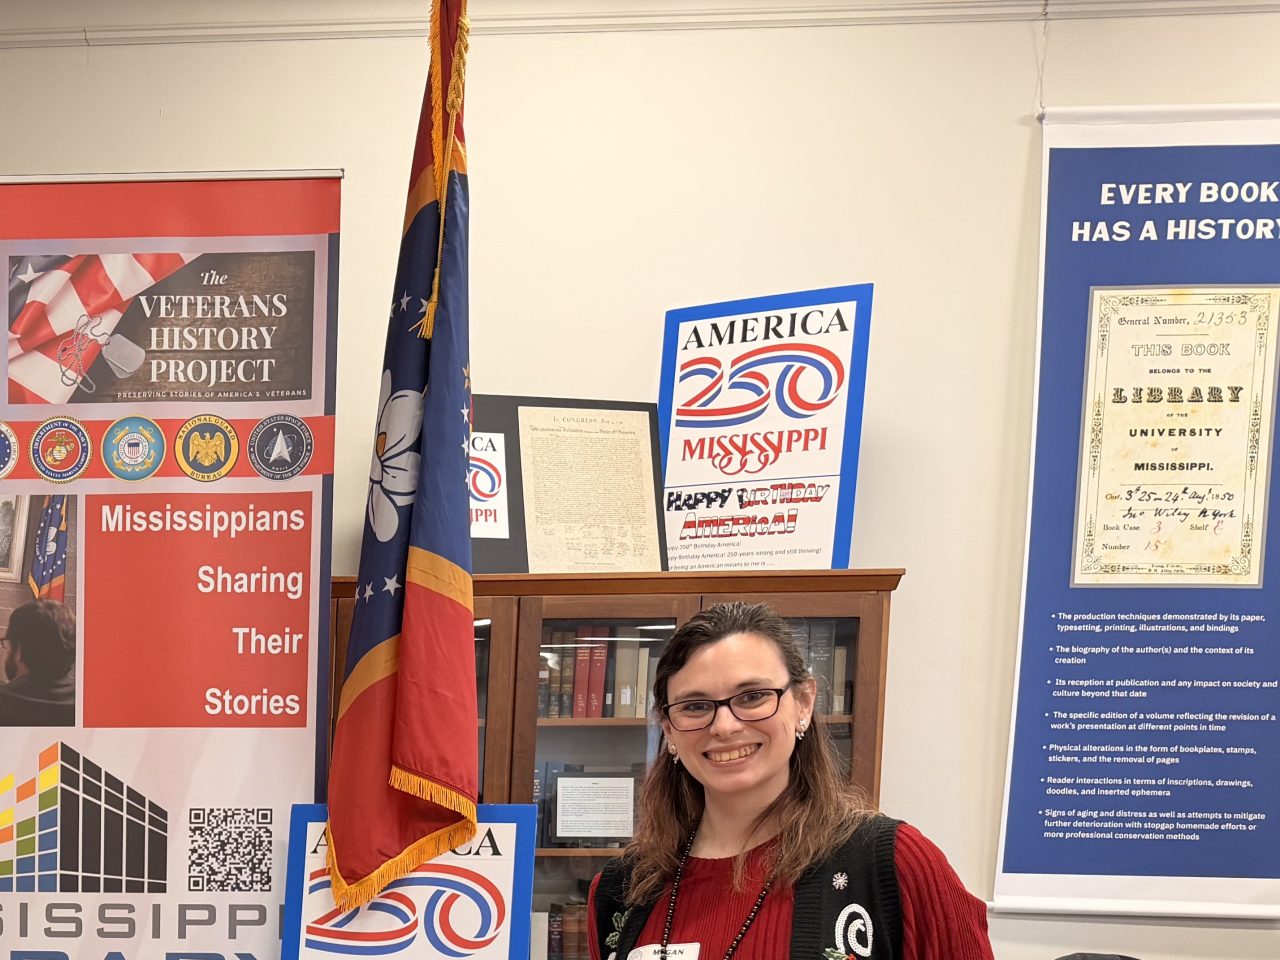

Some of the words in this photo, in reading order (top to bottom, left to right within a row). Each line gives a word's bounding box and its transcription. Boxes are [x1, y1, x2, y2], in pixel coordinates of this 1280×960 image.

[1101, 183, 1192, 204] EVERY
[1200, 182, 1279, 202] BOOK
[1072, 221, 1130, 241] HAS
[1139, 221, 1158, 240] A
[201, 270, 228, 285] The
[139, 293, 287, 319] VETERANS
[682, 307, 849, 350] AMERICA
[1118, 317, 1149, 326] General
[149, 327, 277, 350] HISTORY
[1131, 344, 1172, 356] THIS
[1181, 343, 1230, 356] BOOK
[150, 359, 275, 387] PROJECT
[675, 343, 845, 428] 250
[1112, 386, 1243, 404] LIBRARY
[177, 416, 213, 440] NATIONAL
[214, 418, 236, 441] GUARD
[1130, 428, 1222, 437] UNIVERSITY
[682, 427, 828, 475] MISSISSIPPI
[190, 471, 223, 480] BUREAU
[1134, 462, 1213, 471] MISSISSIPPI.
[102, 504, 304, 538] Mississippians
[198, 566, 302, 599] Sharing
[1058, 612, 1072, 620] The
[1074, 613, 1116, 621] production
[1118, 613, 1160, 621] techniques
[1219, 614, 1228, 622] by
[1057, 624, 1102, 632] typesetting,
[1104, 624, 1137, 632] printing,
[1139, 624, 1188, 632] illustrations,
[1206, 624, 1239, 633] bindings
[232, 627, 303, 654] Their
[205, 688, 299, 714] Stories
